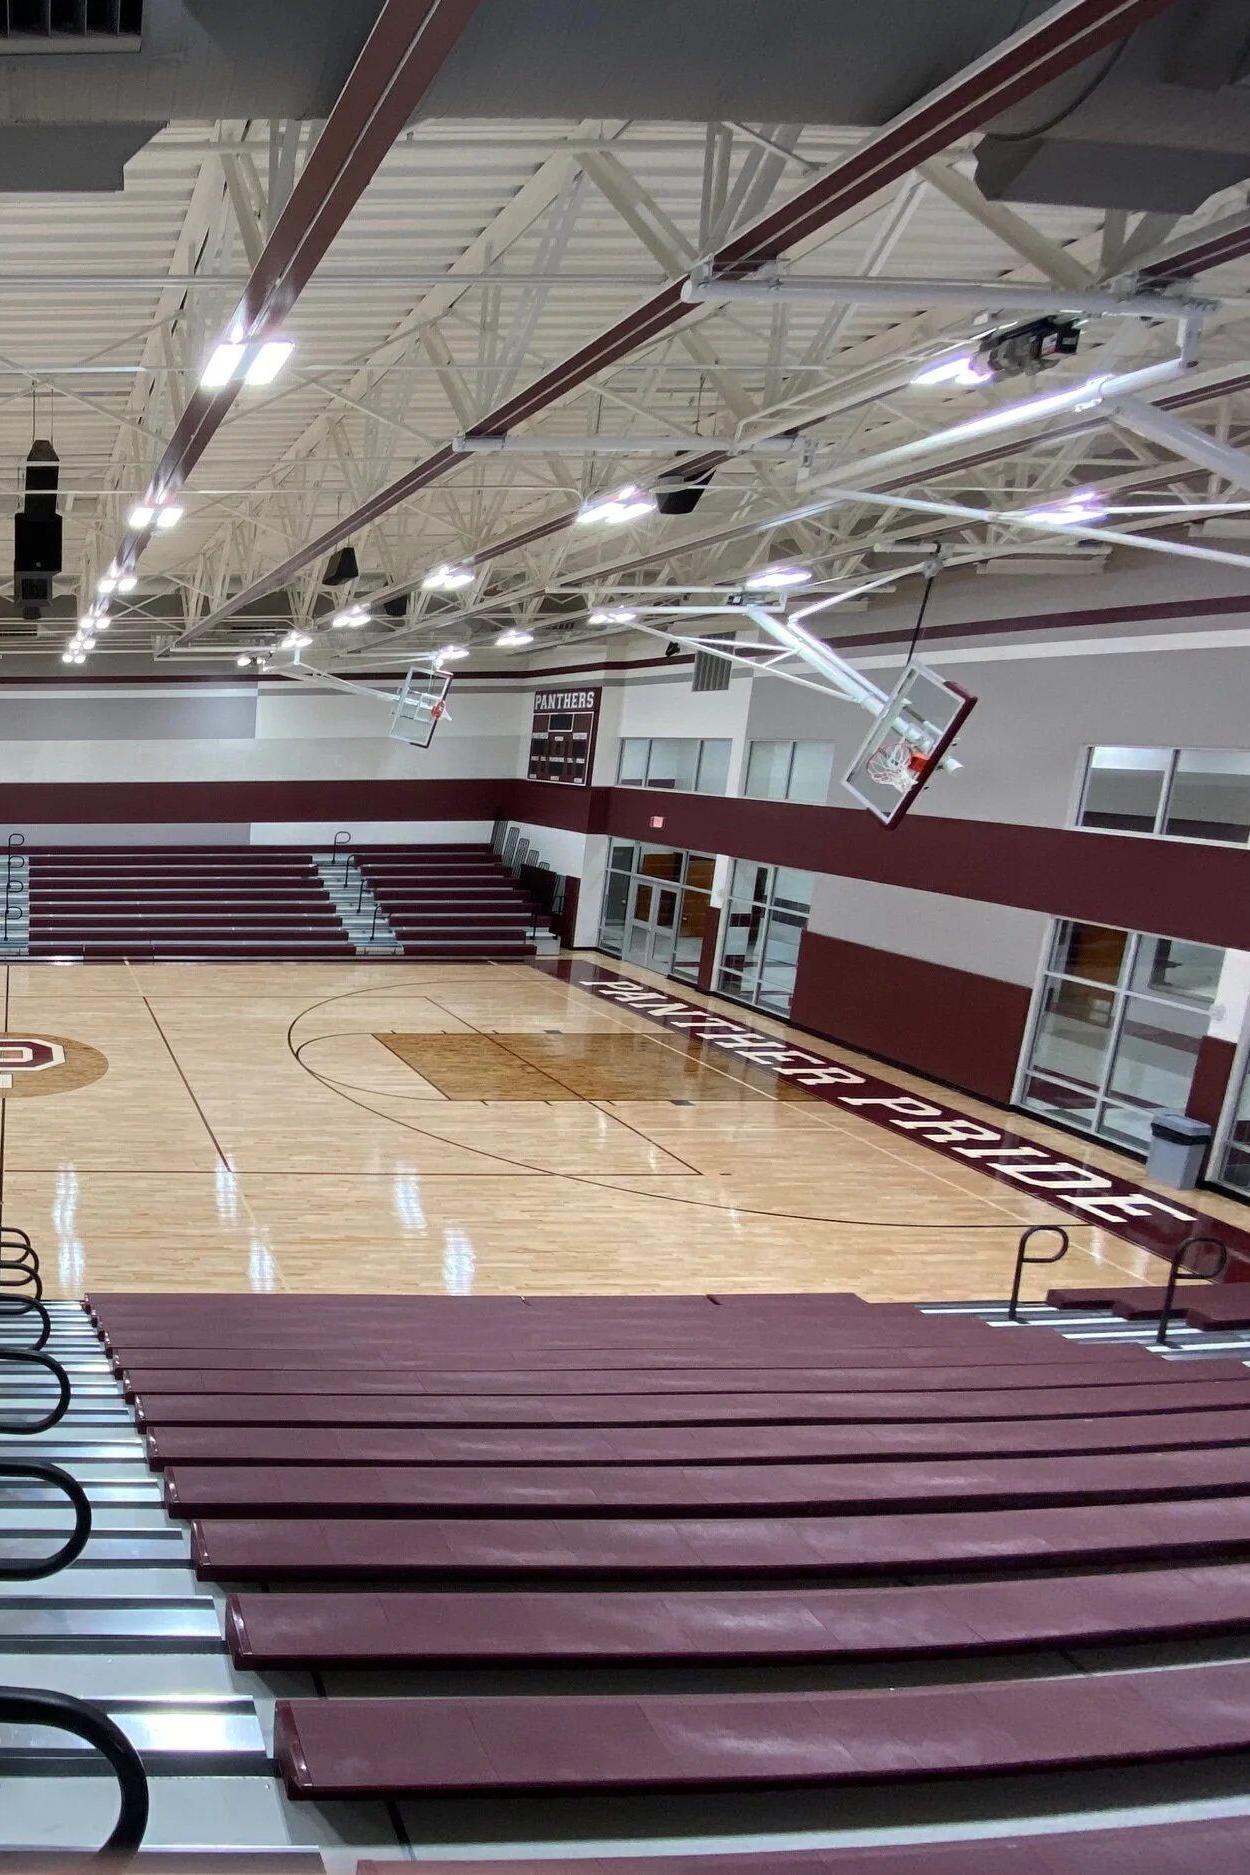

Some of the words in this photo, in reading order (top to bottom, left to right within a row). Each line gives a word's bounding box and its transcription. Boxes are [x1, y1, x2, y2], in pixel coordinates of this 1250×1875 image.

[535, 692, 595, 710] PANTHERS
[578, 981, 866, 1085] PANTHER
[837, 1097, 1198, 1222] PRIDE
